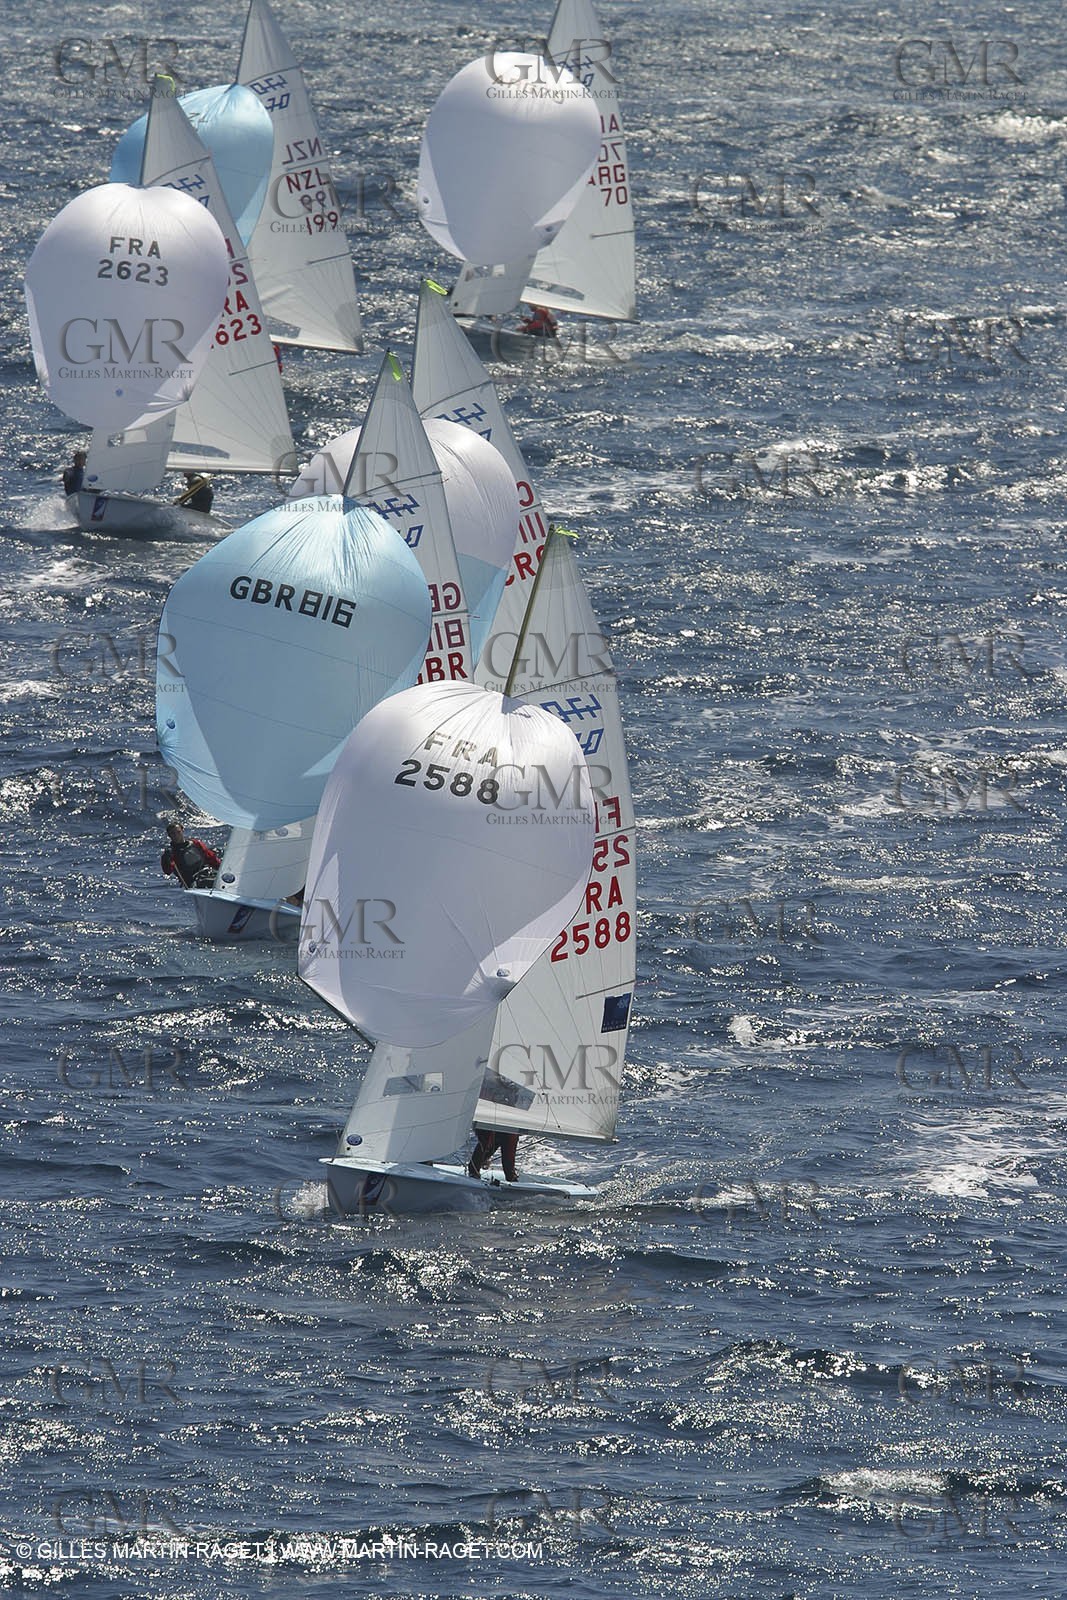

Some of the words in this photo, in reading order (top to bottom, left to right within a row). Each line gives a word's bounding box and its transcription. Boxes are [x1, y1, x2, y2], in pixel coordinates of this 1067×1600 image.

[286, 167, 330, 193] NZL
[600, 186, 628, 207] 70
[306, 211, 338, 235] 199
[109, 236, 161, 259] FRA
[98, 259, 169, 287] 2623
[211, 313, 262, 349] 623
[415, 652, 468, 686] BR
[423, 730, 498, 768] FRA
[394, 759, 500, 804] 2588
[551, 911, 631, 962] 2588
